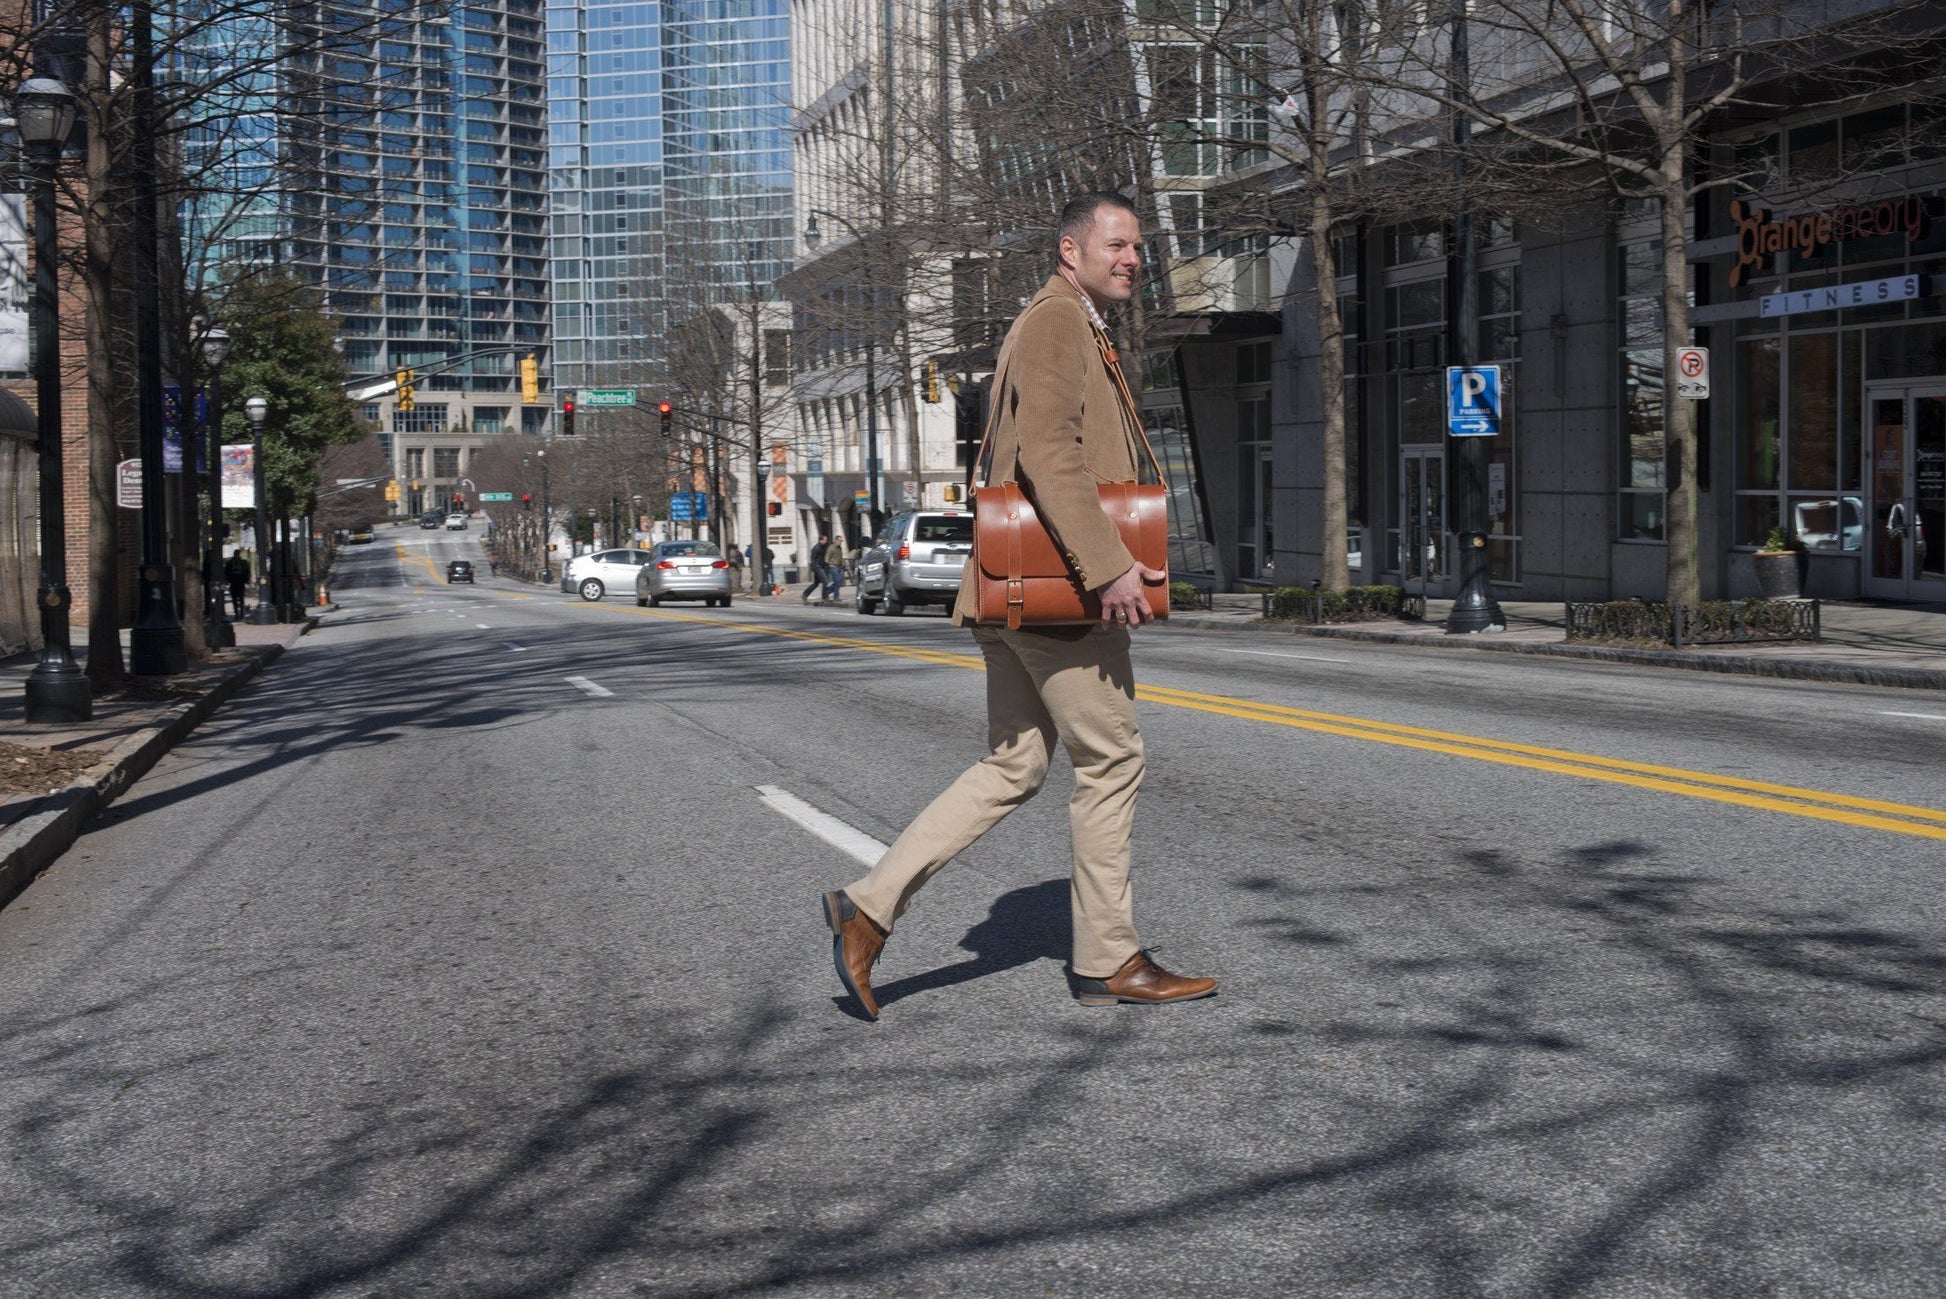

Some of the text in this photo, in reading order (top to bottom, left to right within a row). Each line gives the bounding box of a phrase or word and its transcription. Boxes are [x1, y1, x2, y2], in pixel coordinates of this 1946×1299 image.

[1762, 278, 1914, 316] FITNESS
[587, 392, 627, 404] Peachtree
[1462, 372, 1486, 407] P
